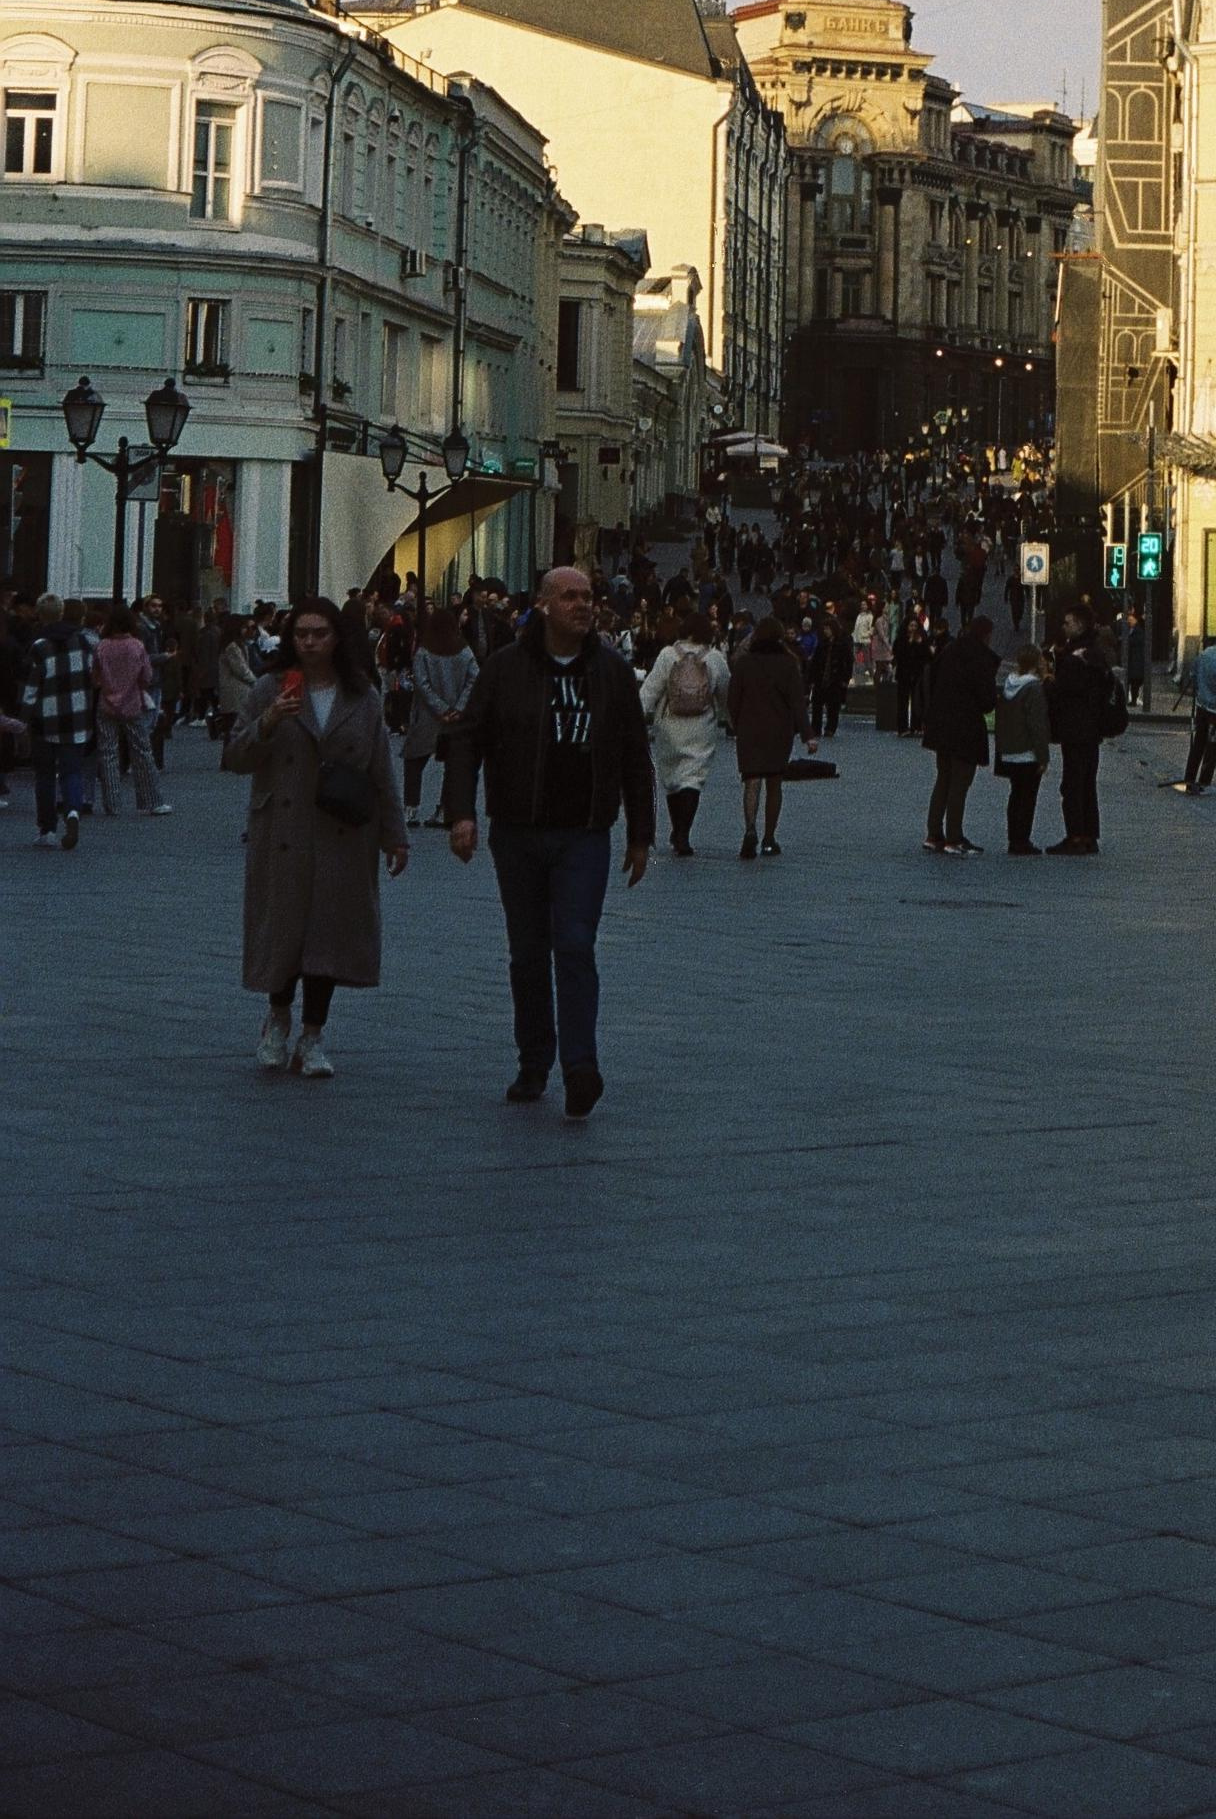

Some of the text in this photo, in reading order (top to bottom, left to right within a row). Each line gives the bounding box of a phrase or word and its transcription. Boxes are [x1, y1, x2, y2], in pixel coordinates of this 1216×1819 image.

[826, 16, 886, 33] БАНКЪ
[1141, 537, 1159, 553] 20
[1113, 547, 1124, 565] 19
